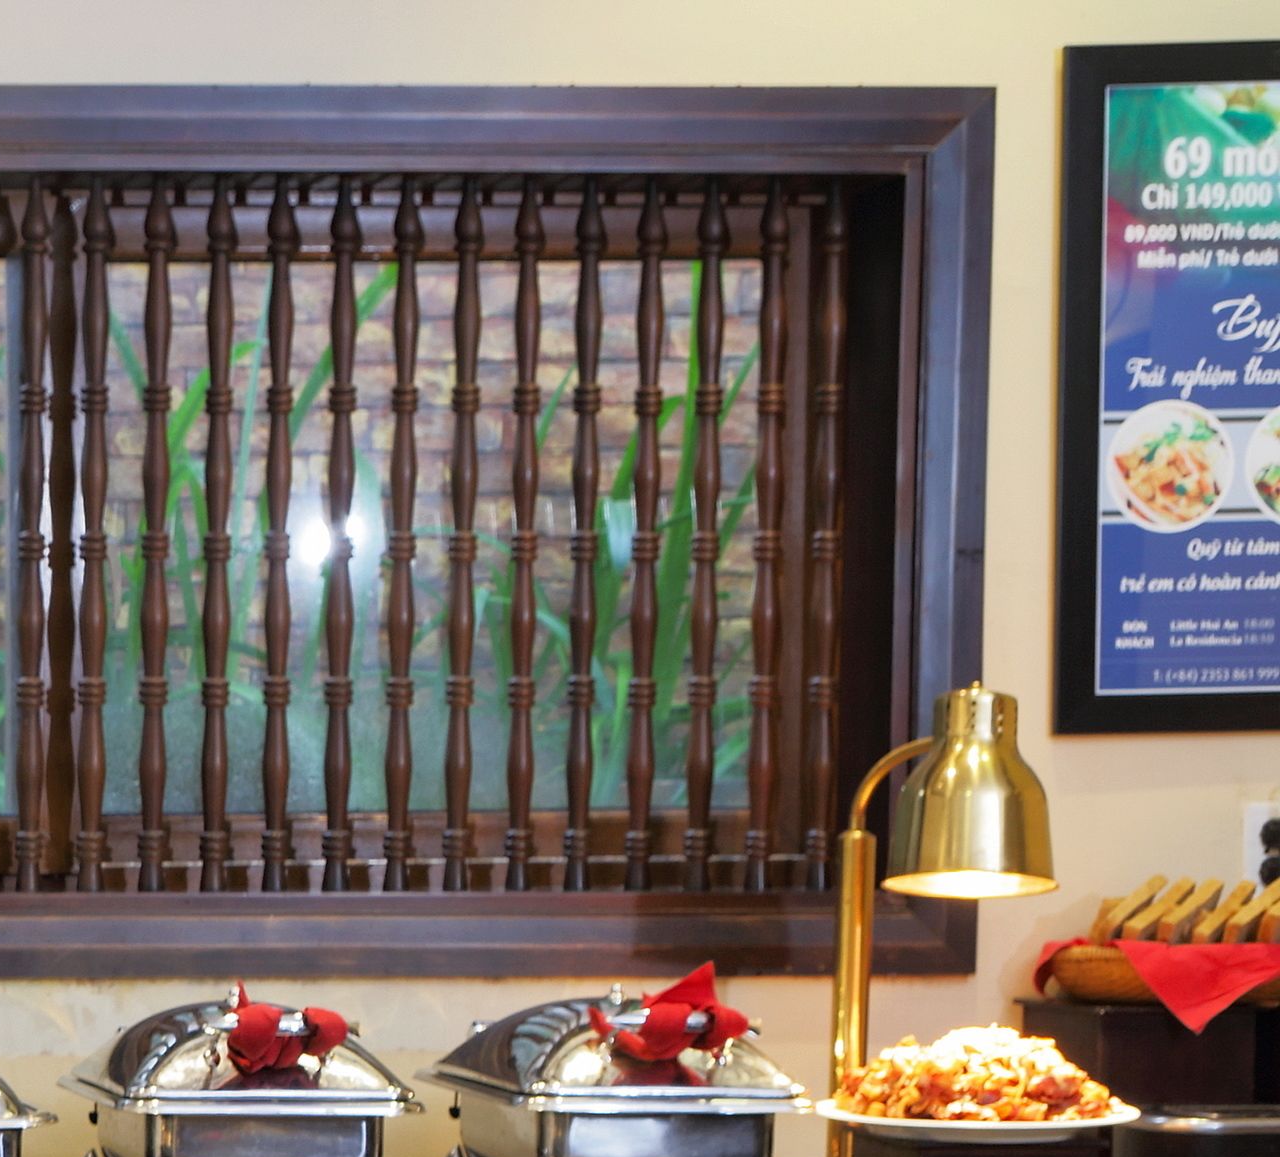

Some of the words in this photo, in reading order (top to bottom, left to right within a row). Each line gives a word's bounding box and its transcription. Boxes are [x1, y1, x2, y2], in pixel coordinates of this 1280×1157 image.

[1164, 136, 1212, 179] 69
[1223, 144, 1280, 177] mó
[1185, 181, 1274, 211] 149,000
